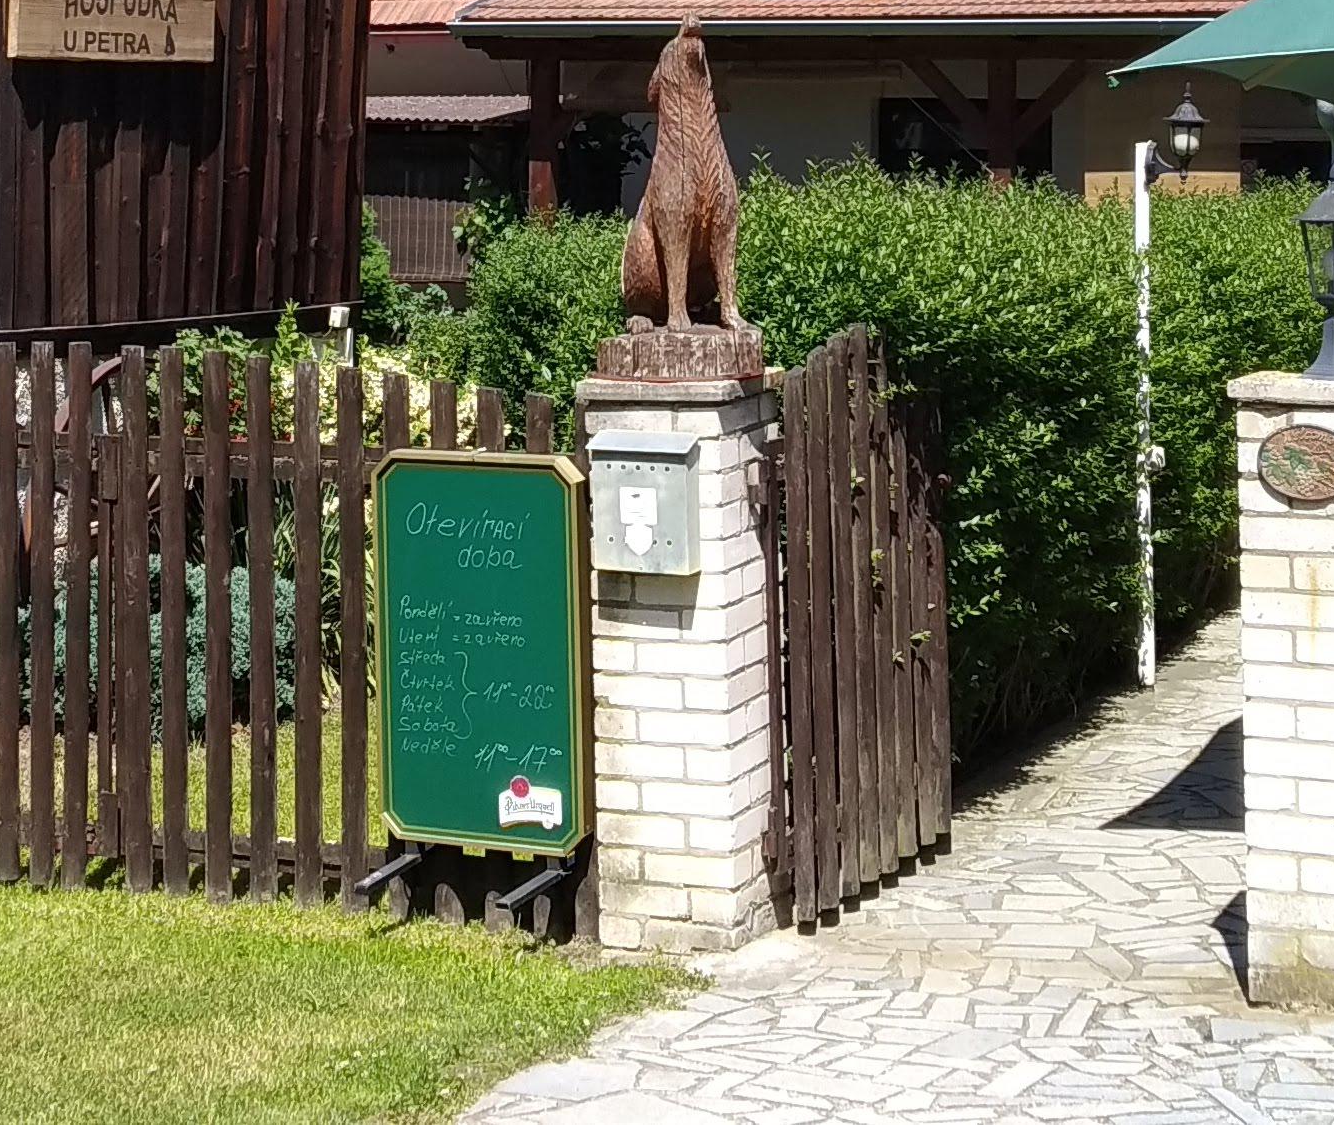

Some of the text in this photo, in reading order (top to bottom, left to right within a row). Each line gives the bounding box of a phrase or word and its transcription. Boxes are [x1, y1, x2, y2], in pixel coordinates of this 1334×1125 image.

[63, 30, 151, 54] U PETRA
[458, 545, 523, 569] doba
[397, 716, 459, 733] Sobota
